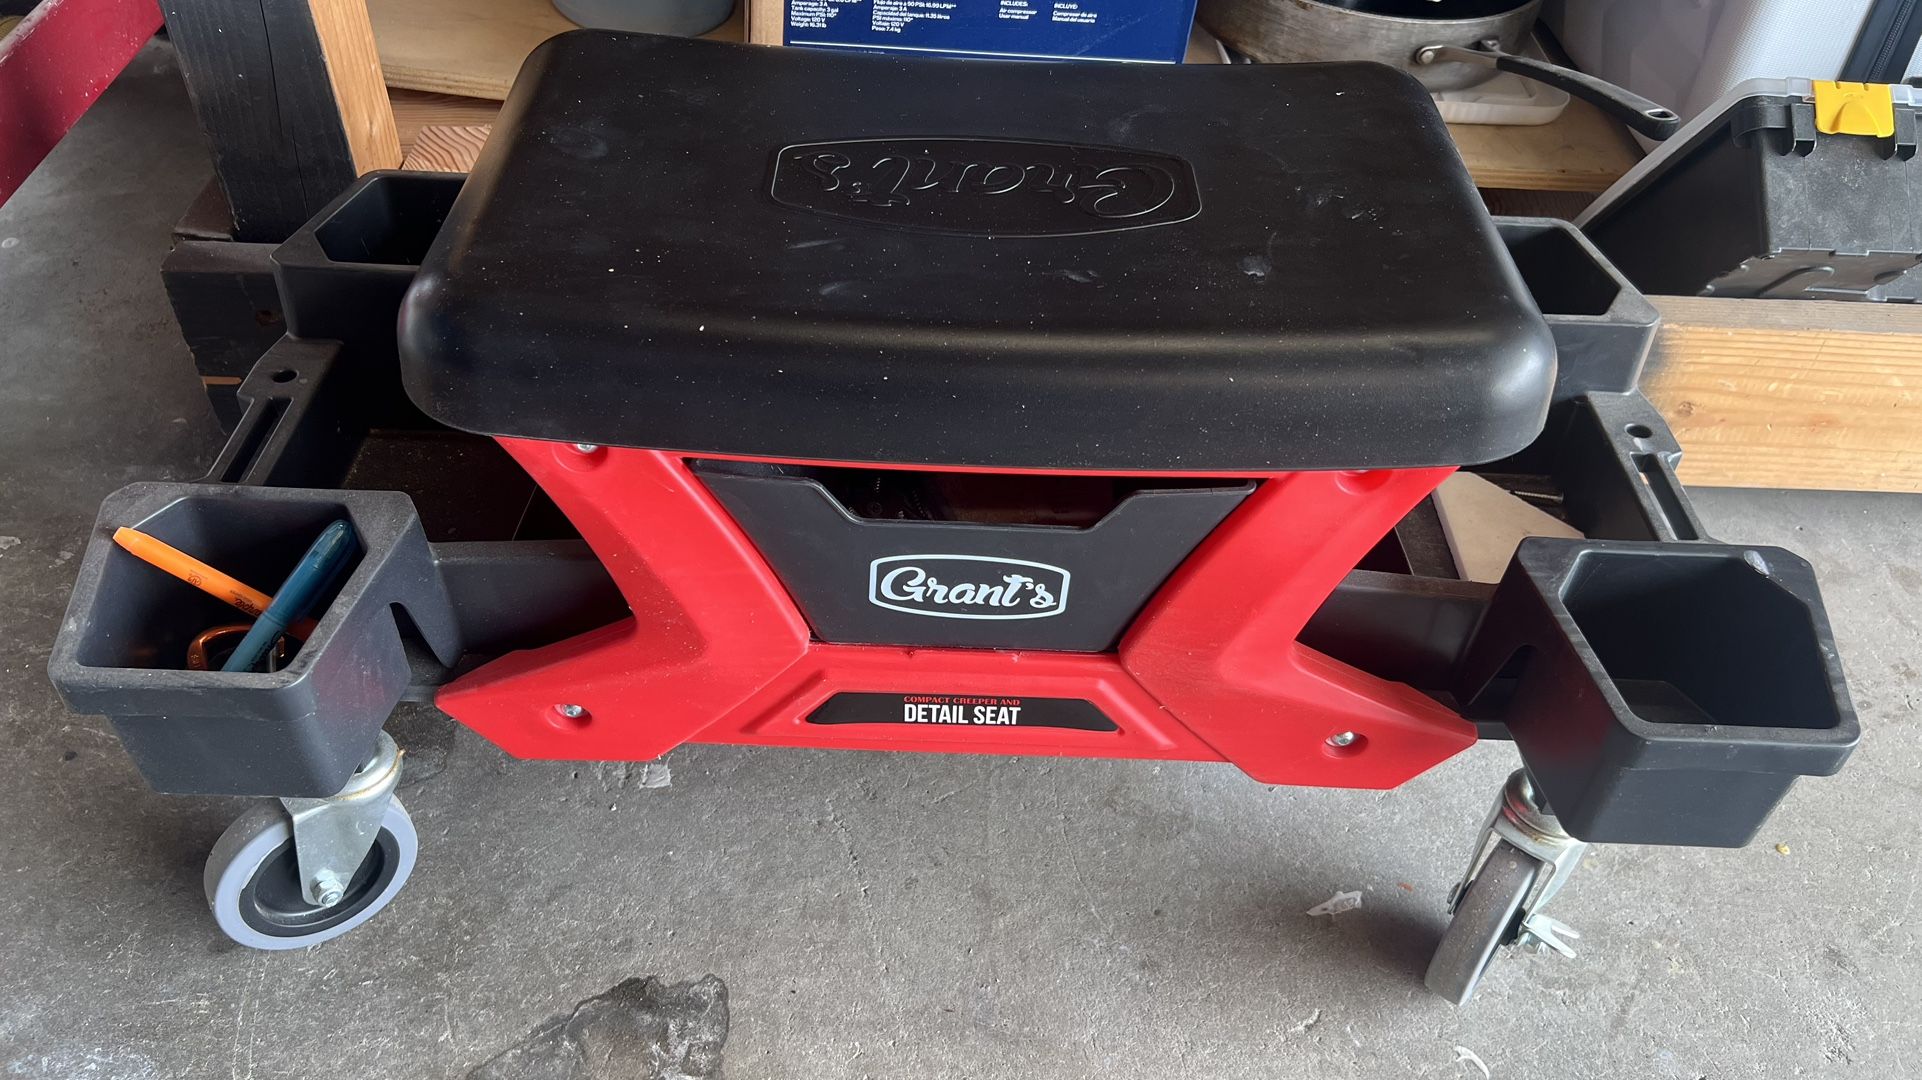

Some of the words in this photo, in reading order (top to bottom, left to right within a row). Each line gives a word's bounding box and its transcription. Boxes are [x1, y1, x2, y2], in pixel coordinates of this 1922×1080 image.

[792, 152, 1176, 219] Grant's
[880, 566, 1057, 608] Grant's
[903, 695, 950, 704] COMPACT
[953, 697, 997, 705] CREEPER
[1000, 698, 1021, 706] AND
[904, 703, 969, 724] DETAIL
[973, 705, 1022, 725] SEAT
